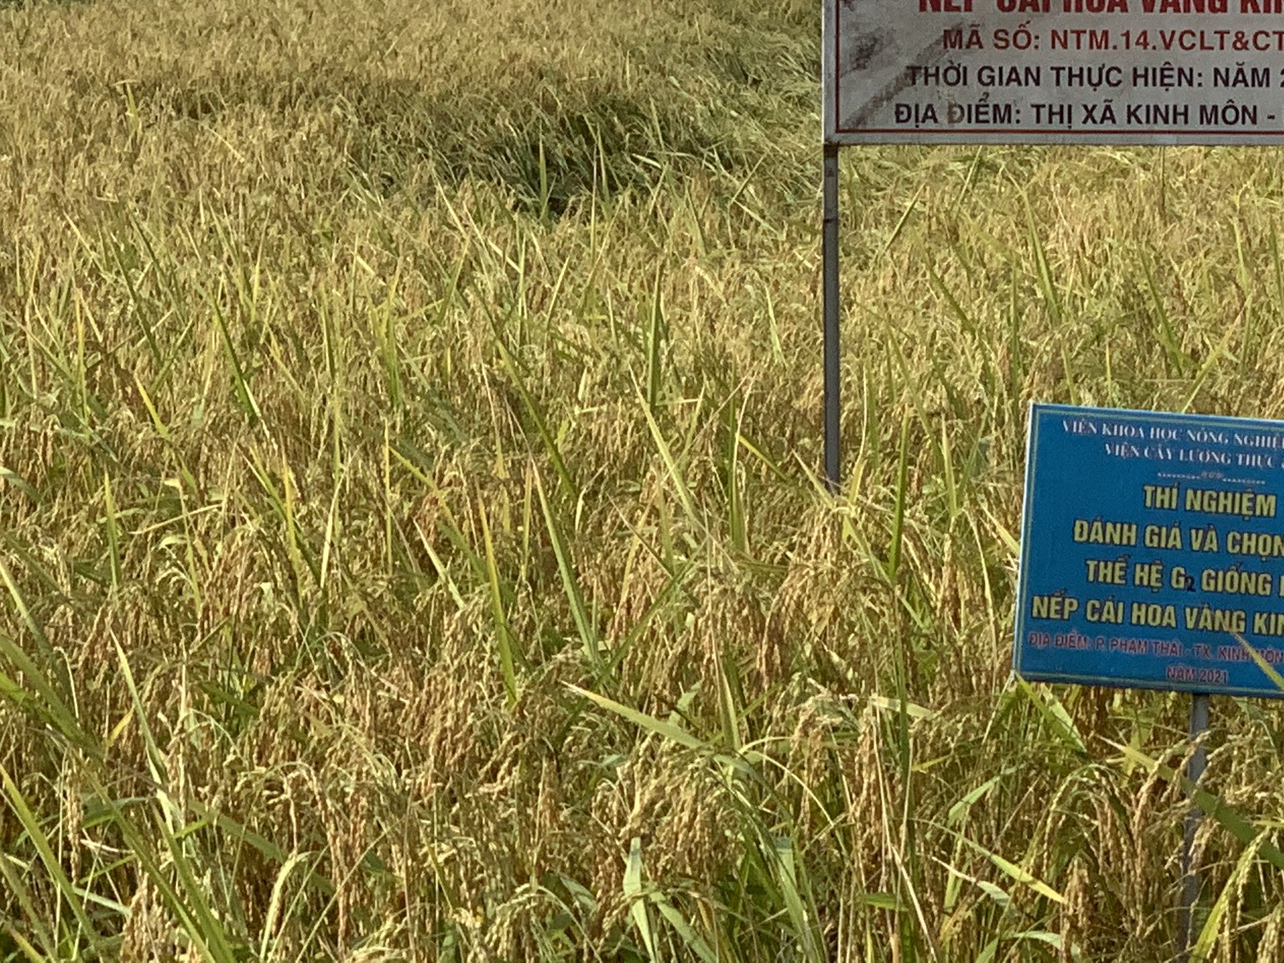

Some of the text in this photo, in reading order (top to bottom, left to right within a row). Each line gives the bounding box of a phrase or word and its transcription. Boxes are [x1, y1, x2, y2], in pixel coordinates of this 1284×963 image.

[943, 24, 983, 50] MÃ
[993, 20, 1039, 50] SỐ:
[907, 60, 967, 86] THỜI
[977, 66, 1040, 86] GIAN
[1050, 64, 1122, 91] THỰC
[1133, 61, 1202, 91] HIỆN:
[1214, 62, 1269, 87] NĂM
[895, 104, 938, 128] ĐỊA
[948, 92, 1021, 124] ĐIỂM:
[1031, 104, 1072, 129] THỊ
[1082, 99, 1116, 124] XÃ
[1127, 104, 1188, 125] KINH
[1200, 99, 1257, 125] MÔN
[1062, 418, 1097, 435] VIỆN
[1102, 423, 1145, 437] KHOA
[1150, 427, 1182, 443] HỌC
[1187, 427, 1228, 444] NÔNG
[1105, 442, 1140, 459] VIỆN
[1145, 444, 1172, 459] CÂY
[1180, 449, 1230, 464] LƯƠNG
[1236, 454, 1274, 470] THỰC
[1143, 482, 1276, 521] THÍ NGHIỆM
[1073, 516, 1137, 546] ĐÁNH
[1144, 521, 1182, 550] GIÁ
[1191, 523, 1218, 552] VÀ
[1086, 554, 1131, 585] THẾ
[1135, 560, 1163, 592] HỆ
[1202, 561, 1272, 596] GIỐNG
[1032, 589, 1078, 619] NẾP
[1086, 595, 1124, 624] CÁI
[1132, 603, 1176, 627] HOA
[1185, 604, 1245, 633] VÀNG
[1201, 669, 1228, 683] 2021
